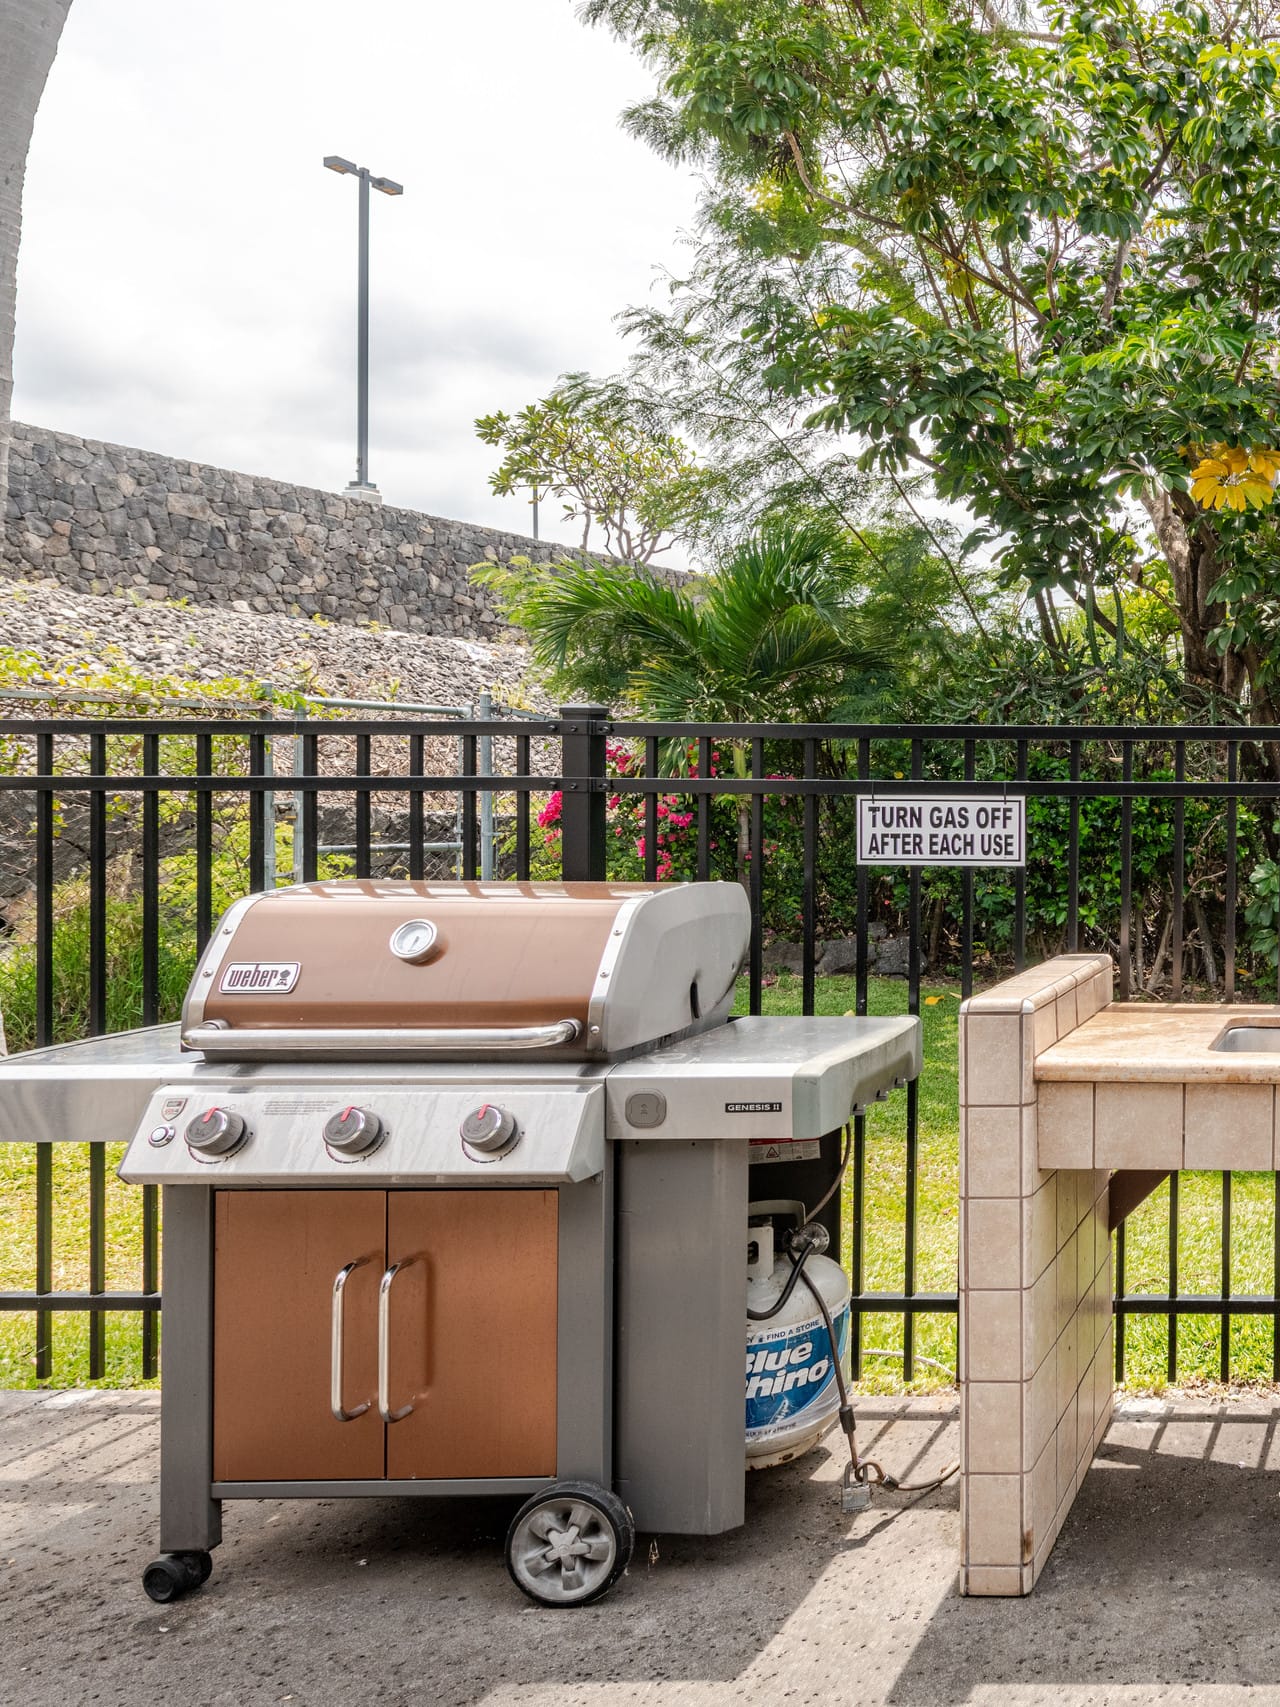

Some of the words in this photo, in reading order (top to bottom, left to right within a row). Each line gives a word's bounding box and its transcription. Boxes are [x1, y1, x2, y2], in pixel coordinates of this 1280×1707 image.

[868, 806, 922, 828] TURN
[930, 806, 969, 829] GAS
[976, 807, 1013, 829] OFF
[868, 833, 923, 855] AFTER
[929, 834, 974, 855] EACH
[981, 834, 1014, 856] USE
[227, 964, 279, 988] weber
[727, 1104, 771, 1112] GENESIS
[766, 1330, 786, 1341] FIND
[795, 1319, 820, 1333] STORE
[746, 1359, 829, 1399] hino
